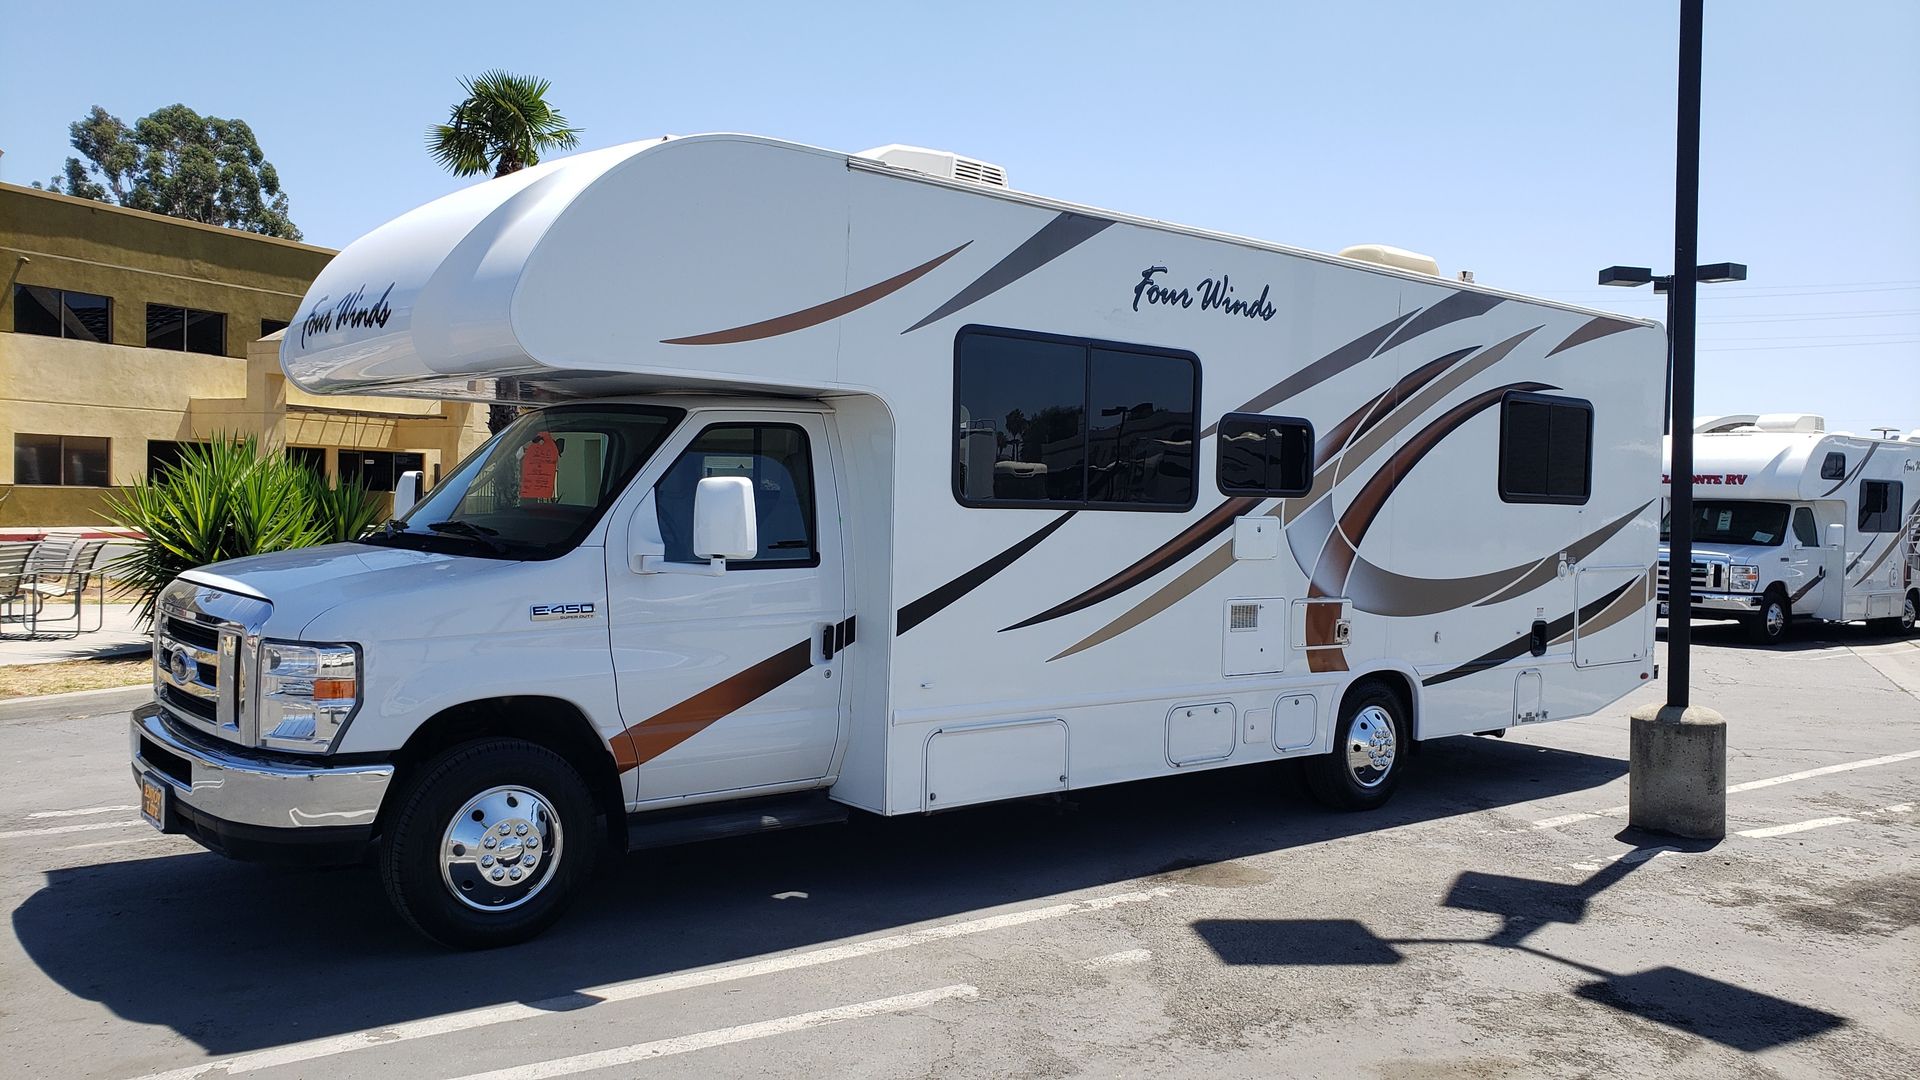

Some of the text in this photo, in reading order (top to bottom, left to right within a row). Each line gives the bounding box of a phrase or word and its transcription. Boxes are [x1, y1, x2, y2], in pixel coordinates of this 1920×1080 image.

[1133, 265, 1277, 321] Four Winds
[301, 281, 396, 349] Four Winds
[1725, 474, 1748, 485] RV
[533, 604, 594, 615] E-450
